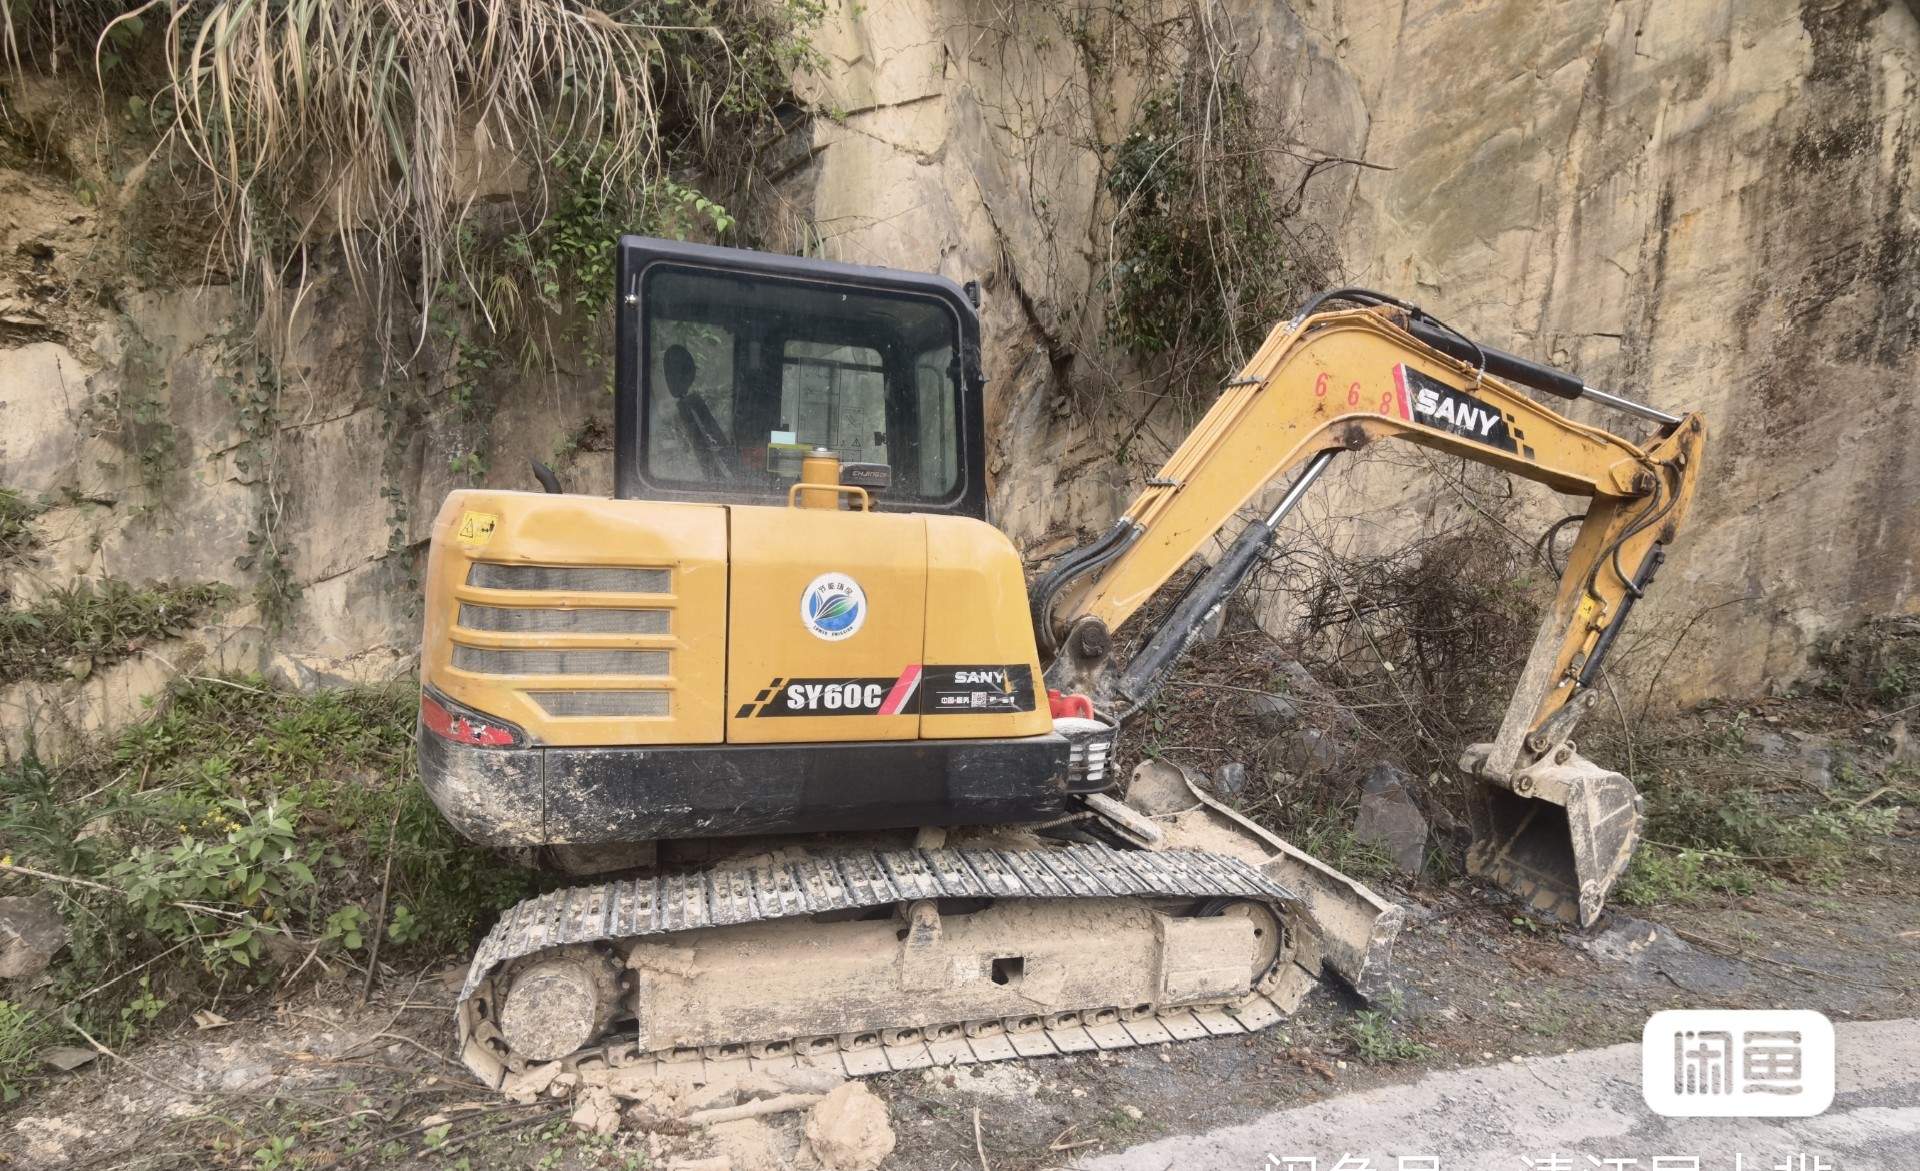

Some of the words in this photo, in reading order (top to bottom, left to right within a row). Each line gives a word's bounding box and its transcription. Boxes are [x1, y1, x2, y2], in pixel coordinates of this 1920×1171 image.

[1415, 388, 1500, 437] SANY
[954, 671, 1004, 684] SANY
[787, 684, 882, 710] SY60C
